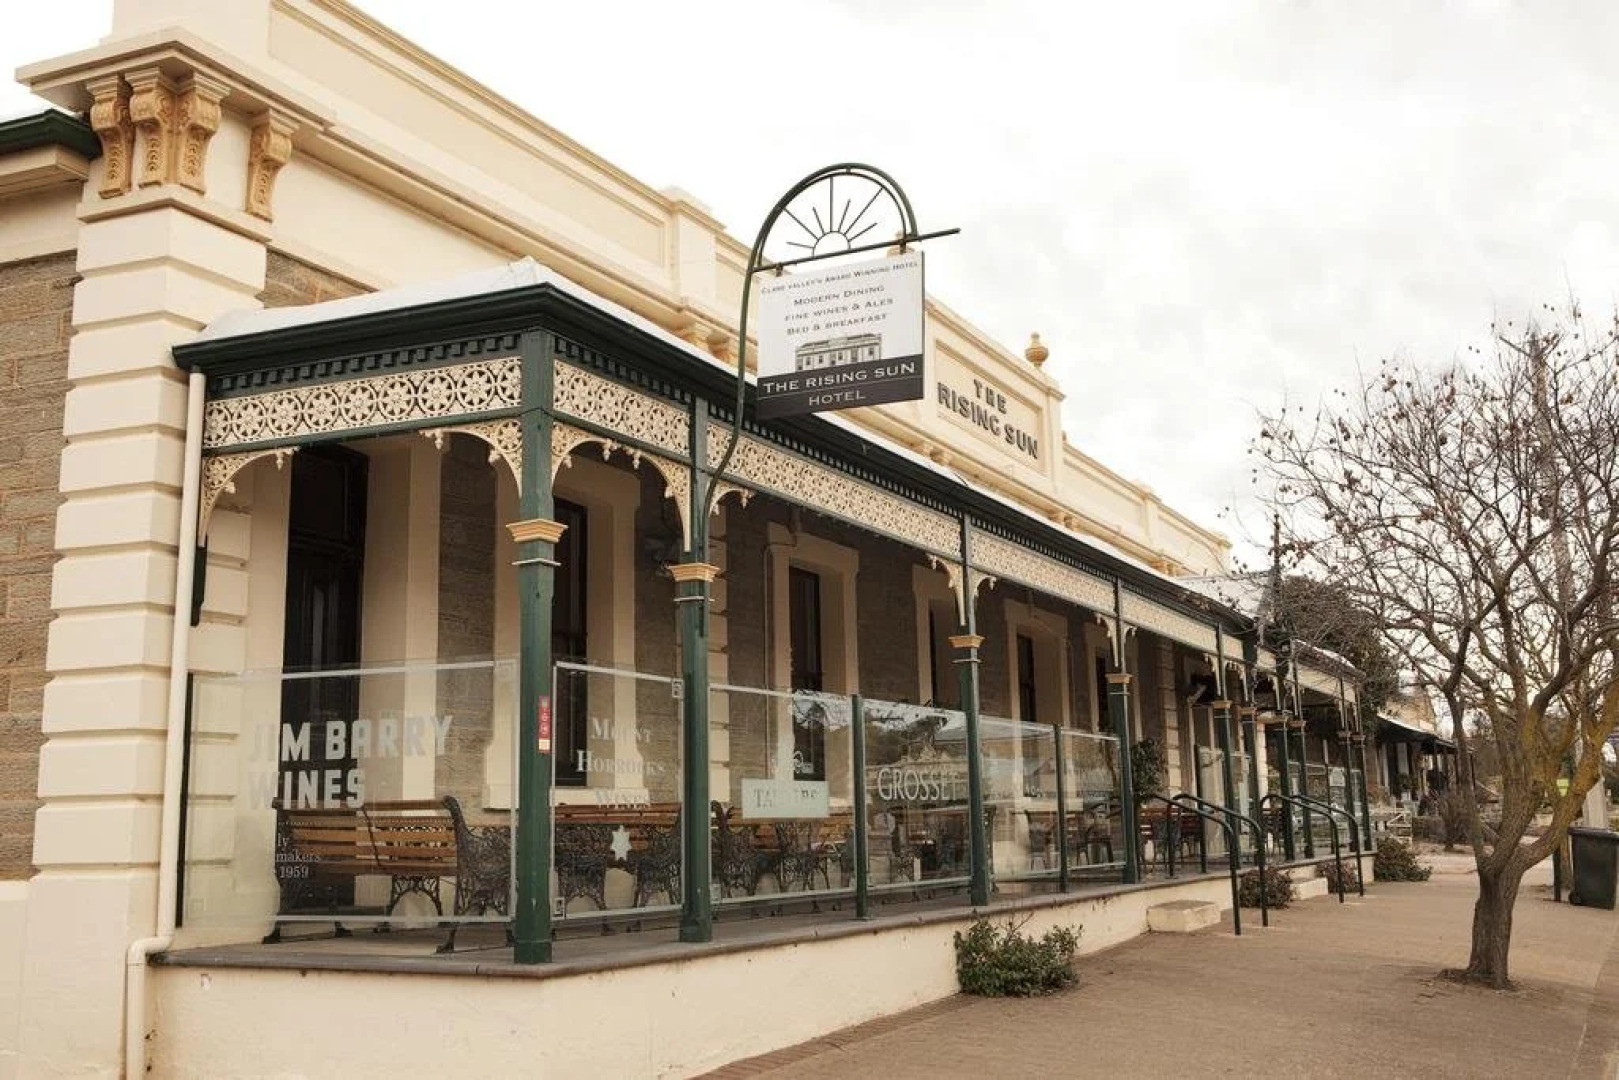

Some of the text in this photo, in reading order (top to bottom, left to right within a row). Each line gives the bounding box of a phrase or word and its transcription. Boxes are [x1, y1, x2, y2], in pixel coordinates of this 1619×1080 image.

[825, 273, 851, 283] AWARD
[892, 261, 918, 271] HOTEL
[794, 285, 885, 306] MODERN DINING
[785, 298, 894, 322] FINE WINES & ALES
[787, 325, 809, 335] BED
[825, 314, 887, 329] BREAKFAST
[763, 362, 915, 393] THE RISING SUN
[808, 390, 866, 406] HOTEL
[974, 379, 1007, 414] THE
[938, 382, 1038, 460] RISING SUN
[325, 716, 453, 760] BARRY
[250, 769, 365, 809] WINES
[280, 866, 308, 878] 1959
